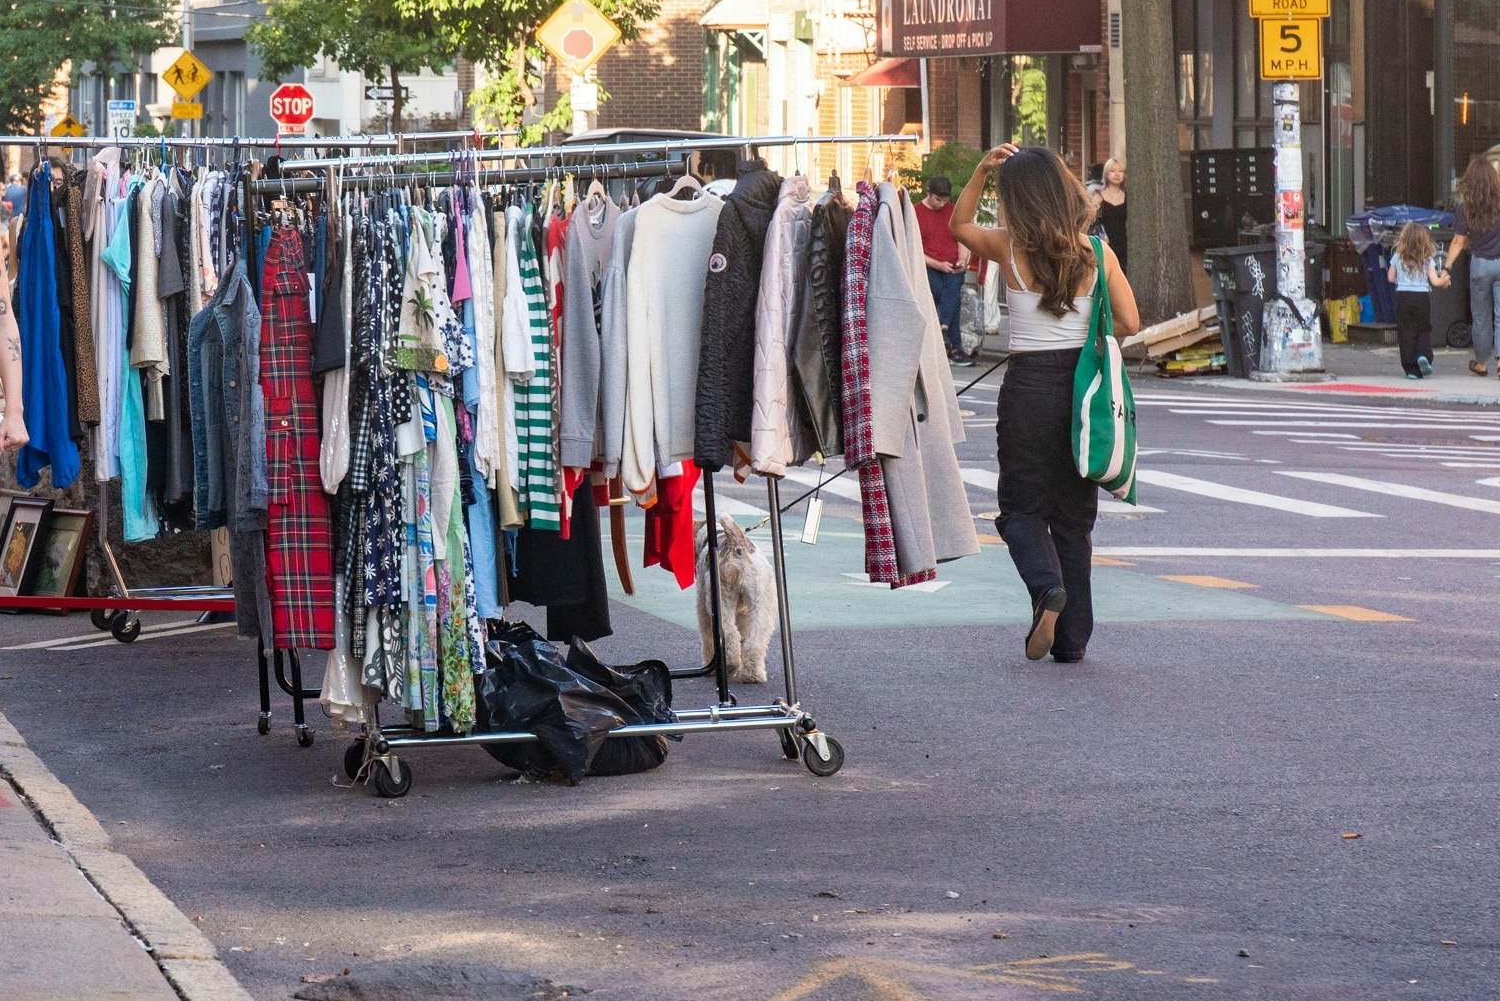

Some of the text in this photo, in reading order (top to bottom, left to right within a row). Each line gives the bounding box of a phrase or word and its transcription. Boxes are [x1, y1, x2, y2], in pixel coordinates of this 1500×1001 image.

[903, 35, 916, 51] SELF
[916, 34, 938, 50] SERVICE
[941, 33, 956, 49] DROP
[956, 33, 967, 48] OFF
[971, 32, 985, 48] PICK
[985, 31, 993, 47] UP
[1280, 25, 1302, 53] 5
[1271, 59, 1312, 71] M.P.H.
[273, 97, 312, 115] STOP
[113, 126, 130, 138] 10
